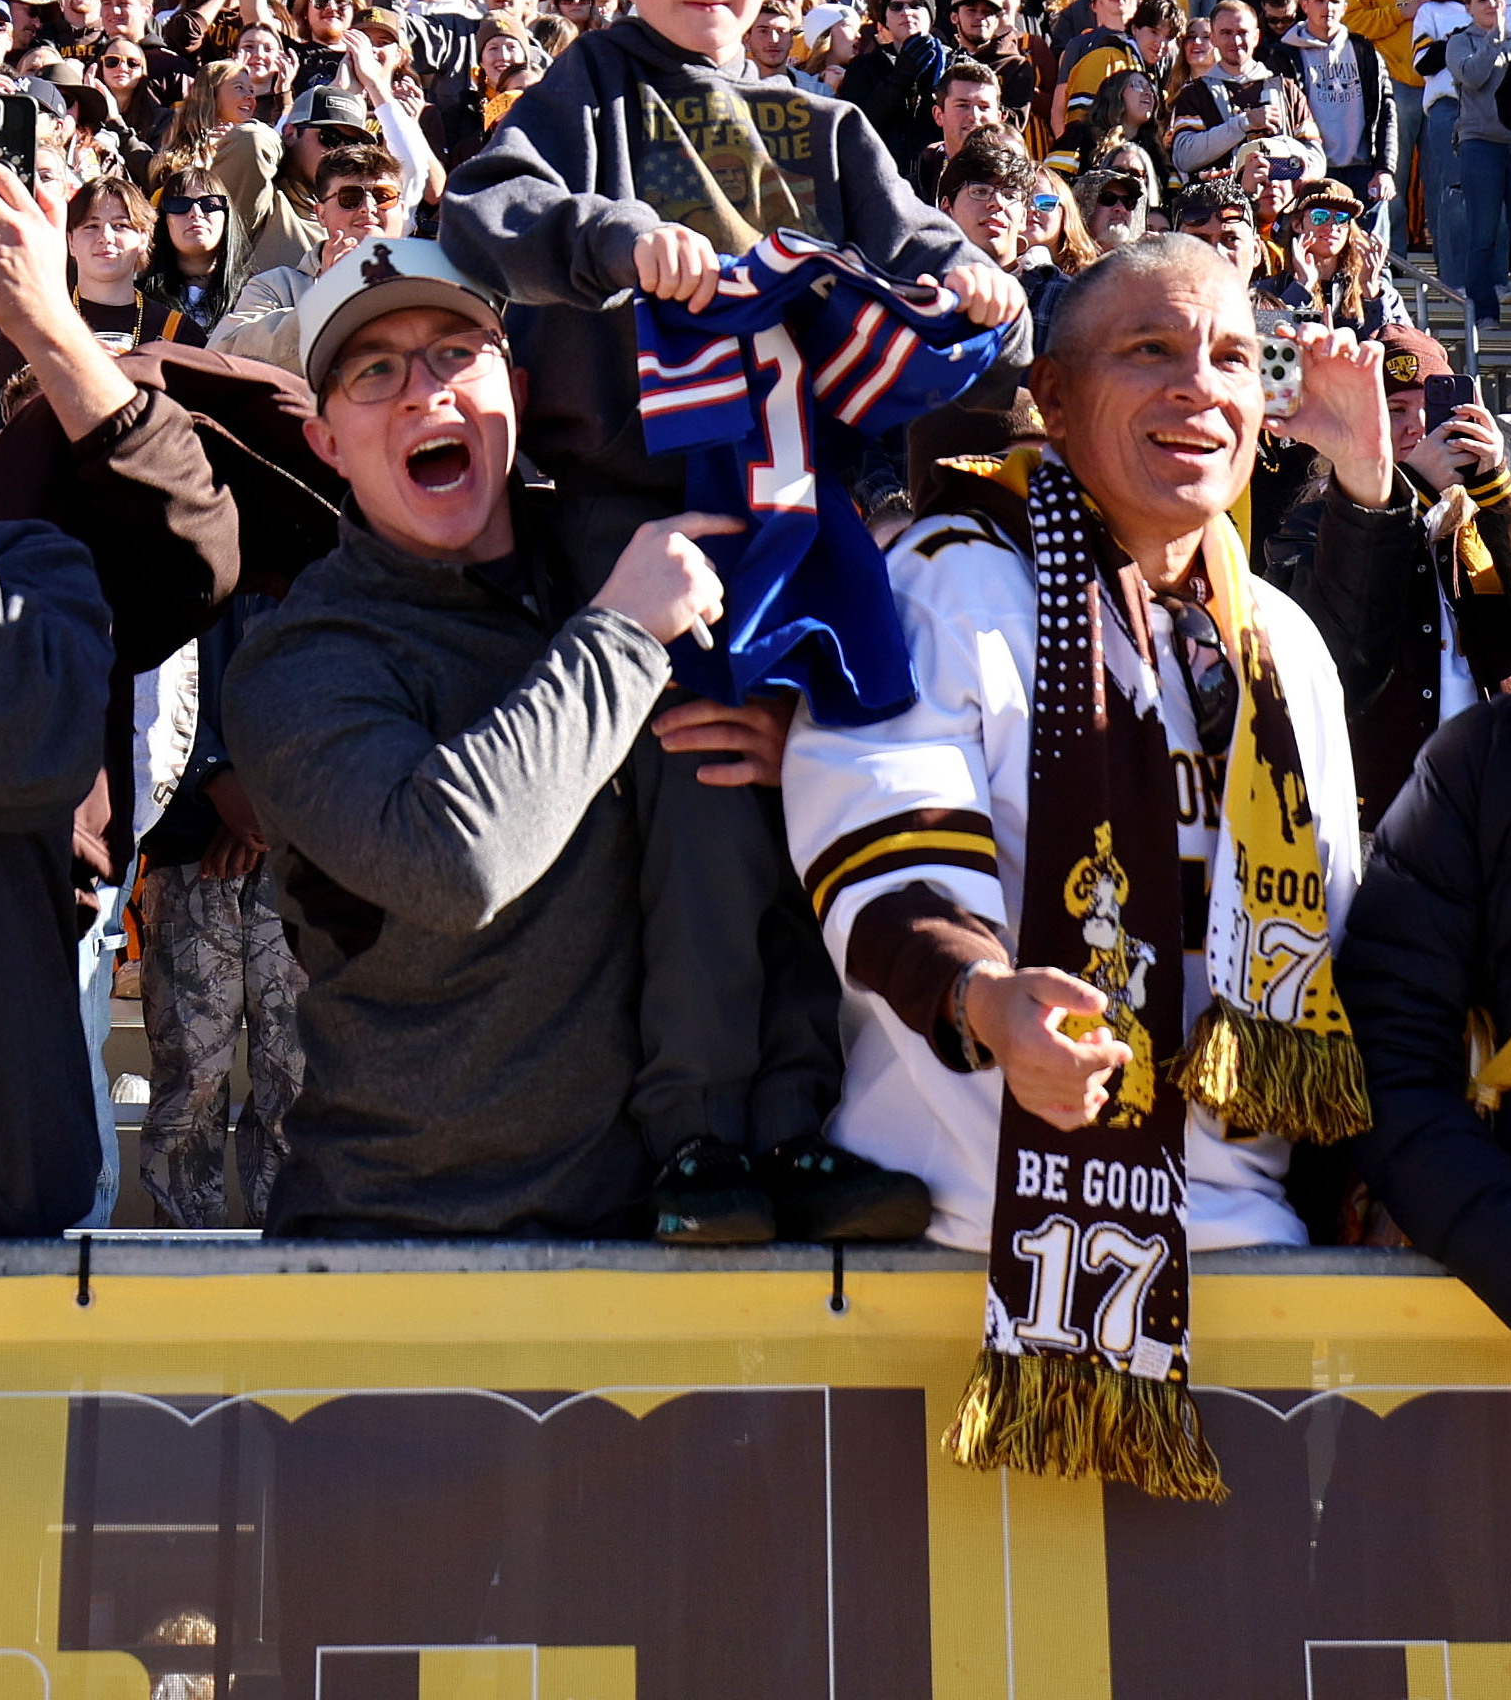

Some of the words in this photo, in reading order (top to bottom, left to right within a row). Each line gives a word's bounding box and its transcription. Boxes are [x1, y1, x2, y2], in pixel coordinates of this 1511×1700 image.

[1314, 60, 1358, 84] WYOMIN
[1255, 864, 1326, 912] GOO
[1234, 907, 1331, 1026] 17
[1015, 1148, 1070, 1203] BE
[1082, 1157, 1171, 1216] GOOD
[1011, 1212, 1170, 1359] 17
